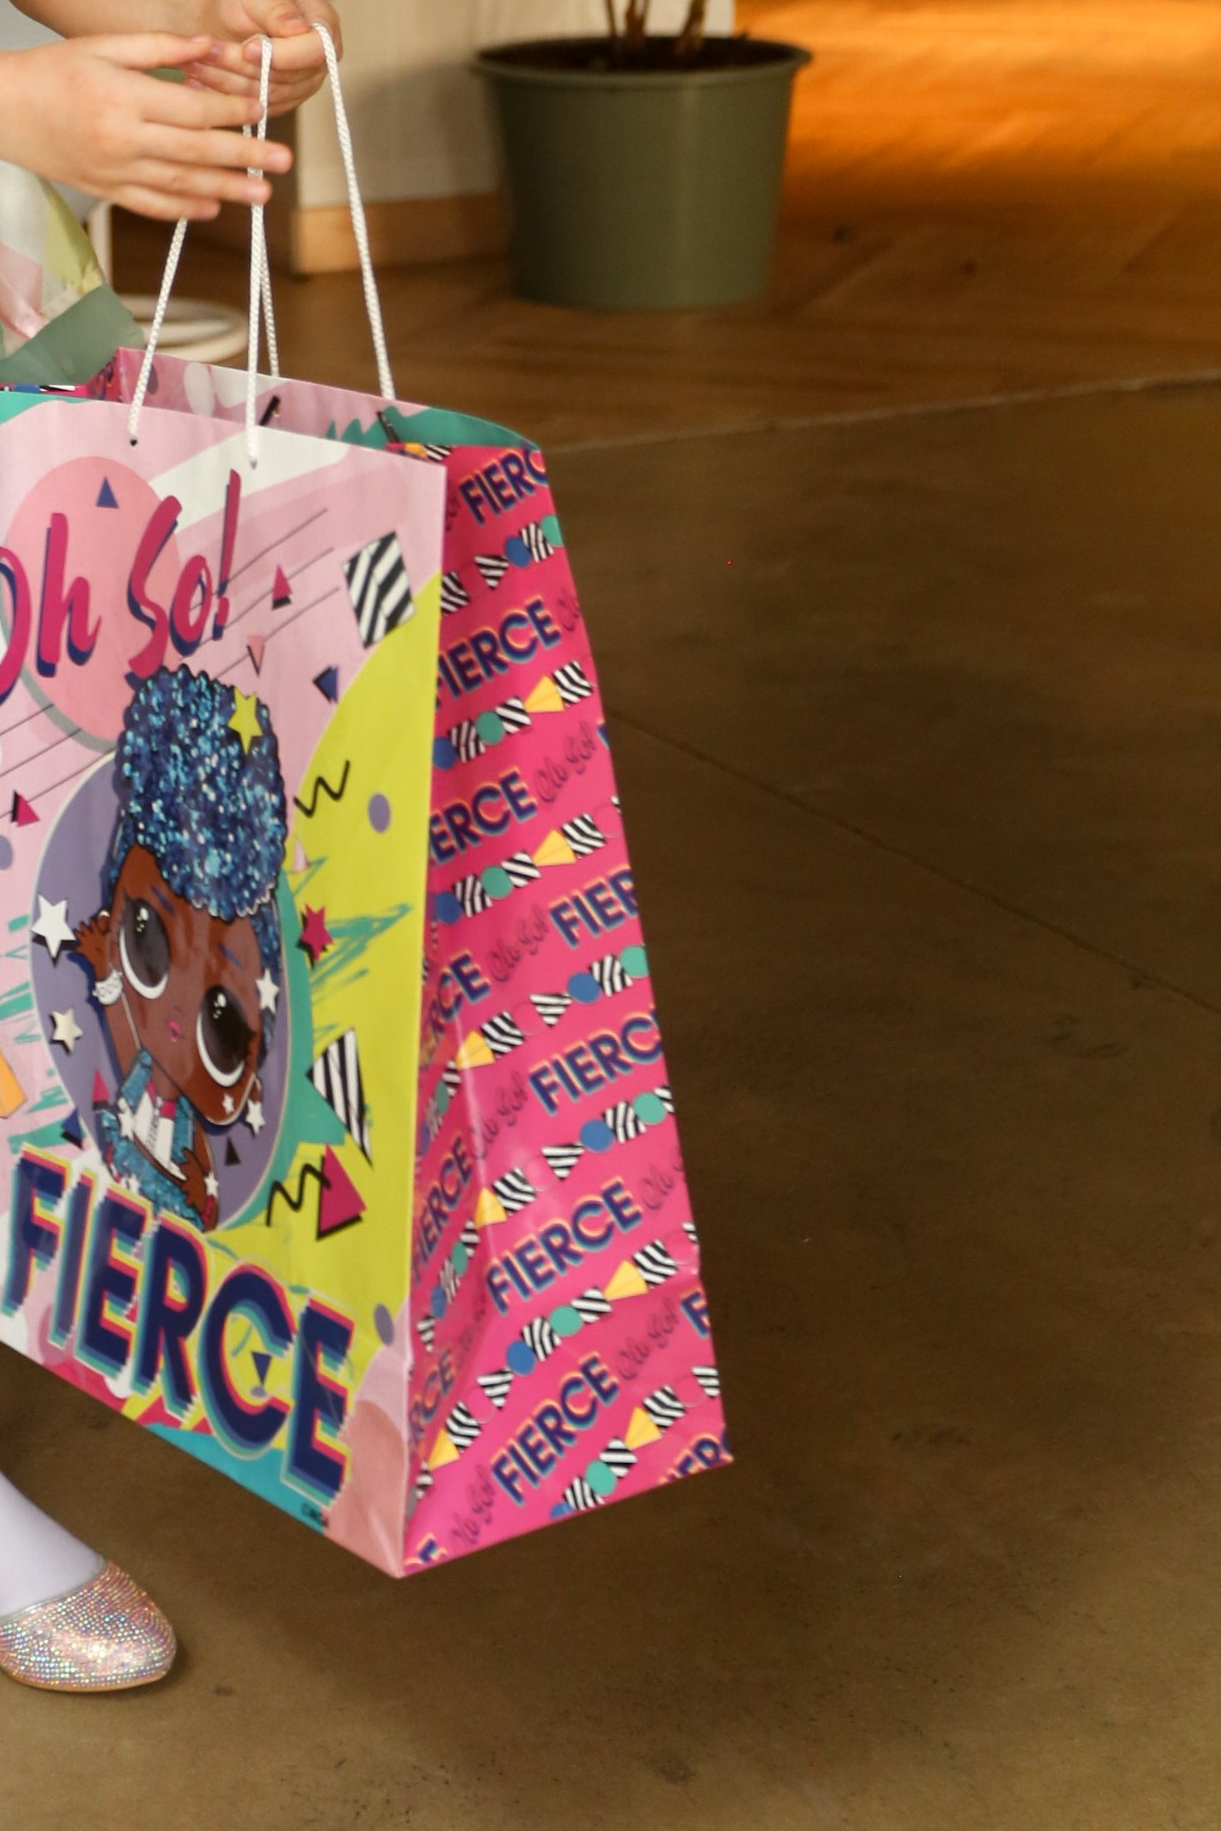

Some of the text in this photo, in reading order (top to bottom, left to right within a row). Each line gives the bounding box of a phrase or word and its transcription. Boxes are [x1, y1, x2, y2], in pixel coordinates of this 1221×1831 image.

[457, 448, 550, 527] FIERC
[125, 468, 242, 692] So!
[435, 594, 562, 711] IERCE
[528, 1004, 664, 1116] FIERC
[485, 1175, 643, 1315] FIERCE
[0, 1142, 356, 1509] FIERCE
[491, 1350, 620, 1507] FIERCE
